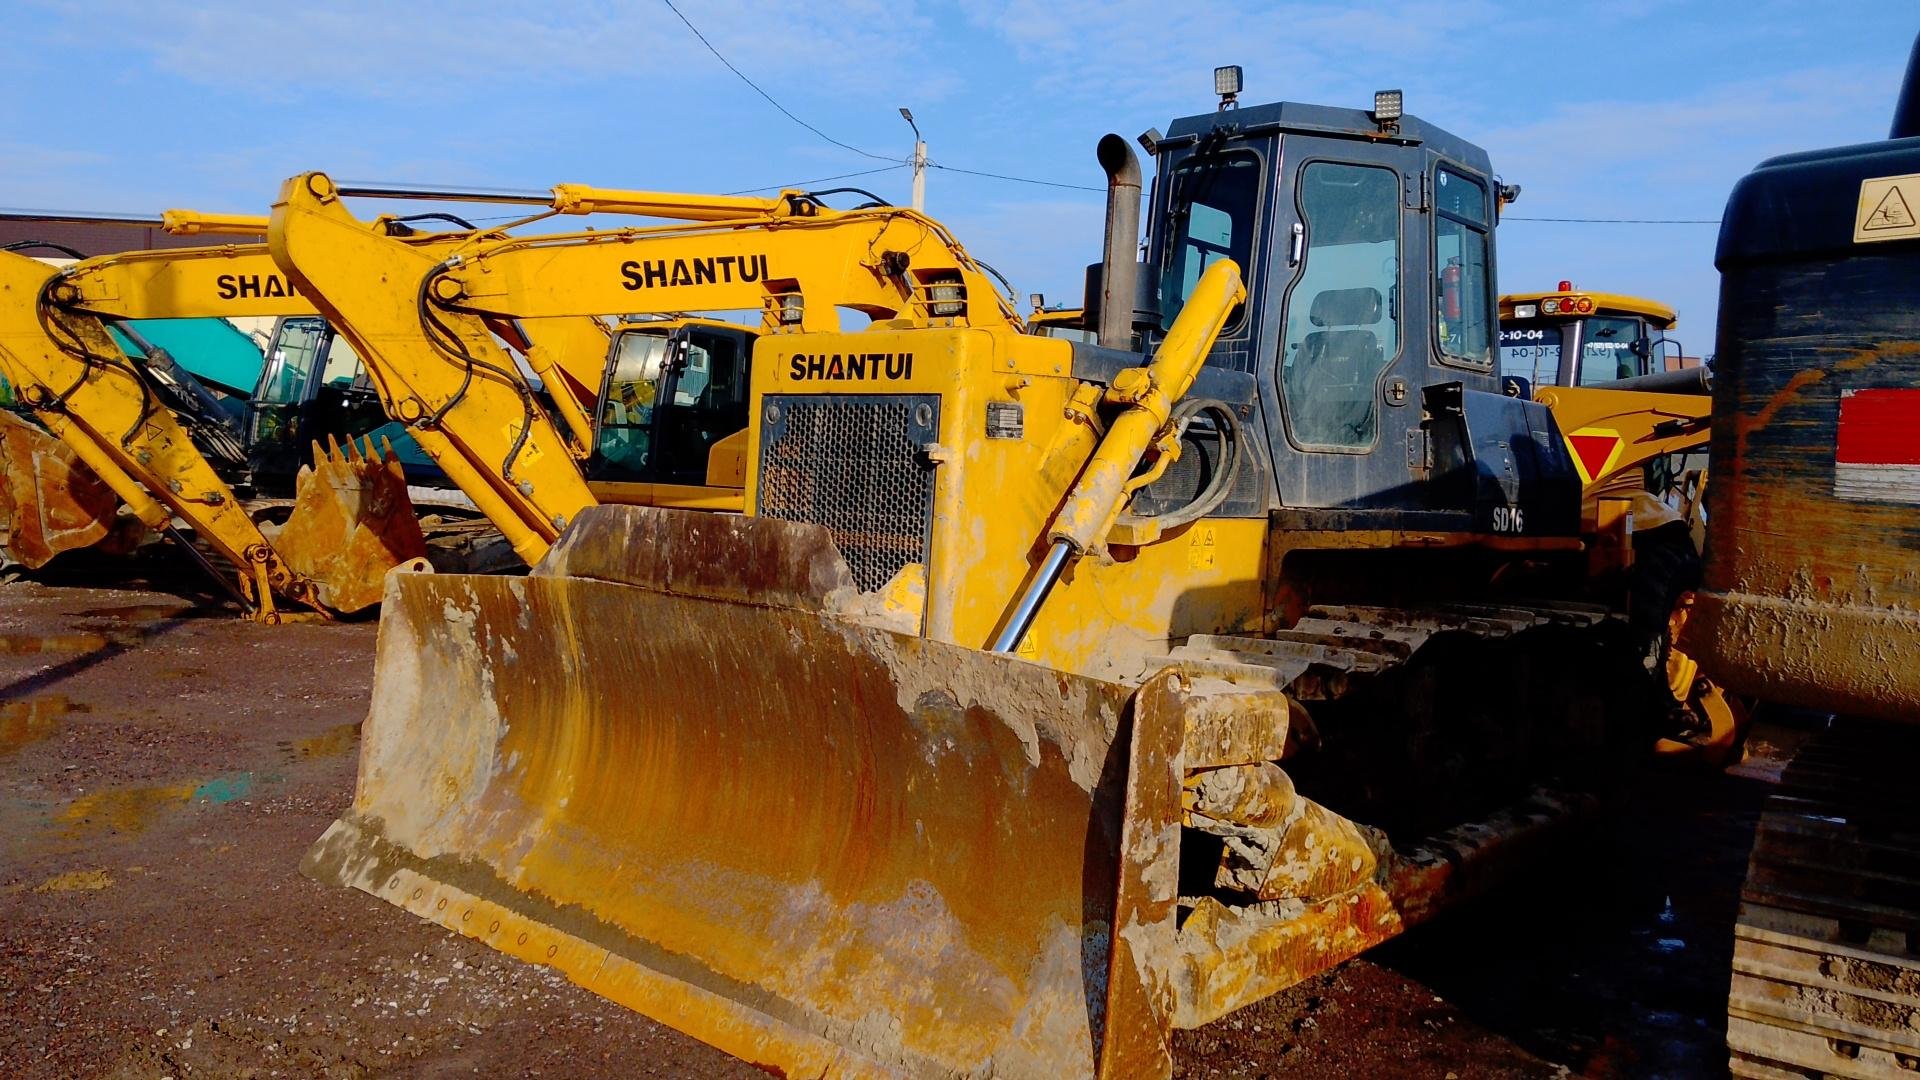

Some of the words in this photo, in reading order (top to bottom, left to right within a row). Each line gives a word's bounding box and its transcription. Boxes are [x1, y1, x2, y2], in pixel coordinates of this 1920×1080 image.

[620, 254, 769, 291] SHANTUI
[789, 353, 913, 381] SHANTUI
[1493, 506, 1524, 533] SD16
